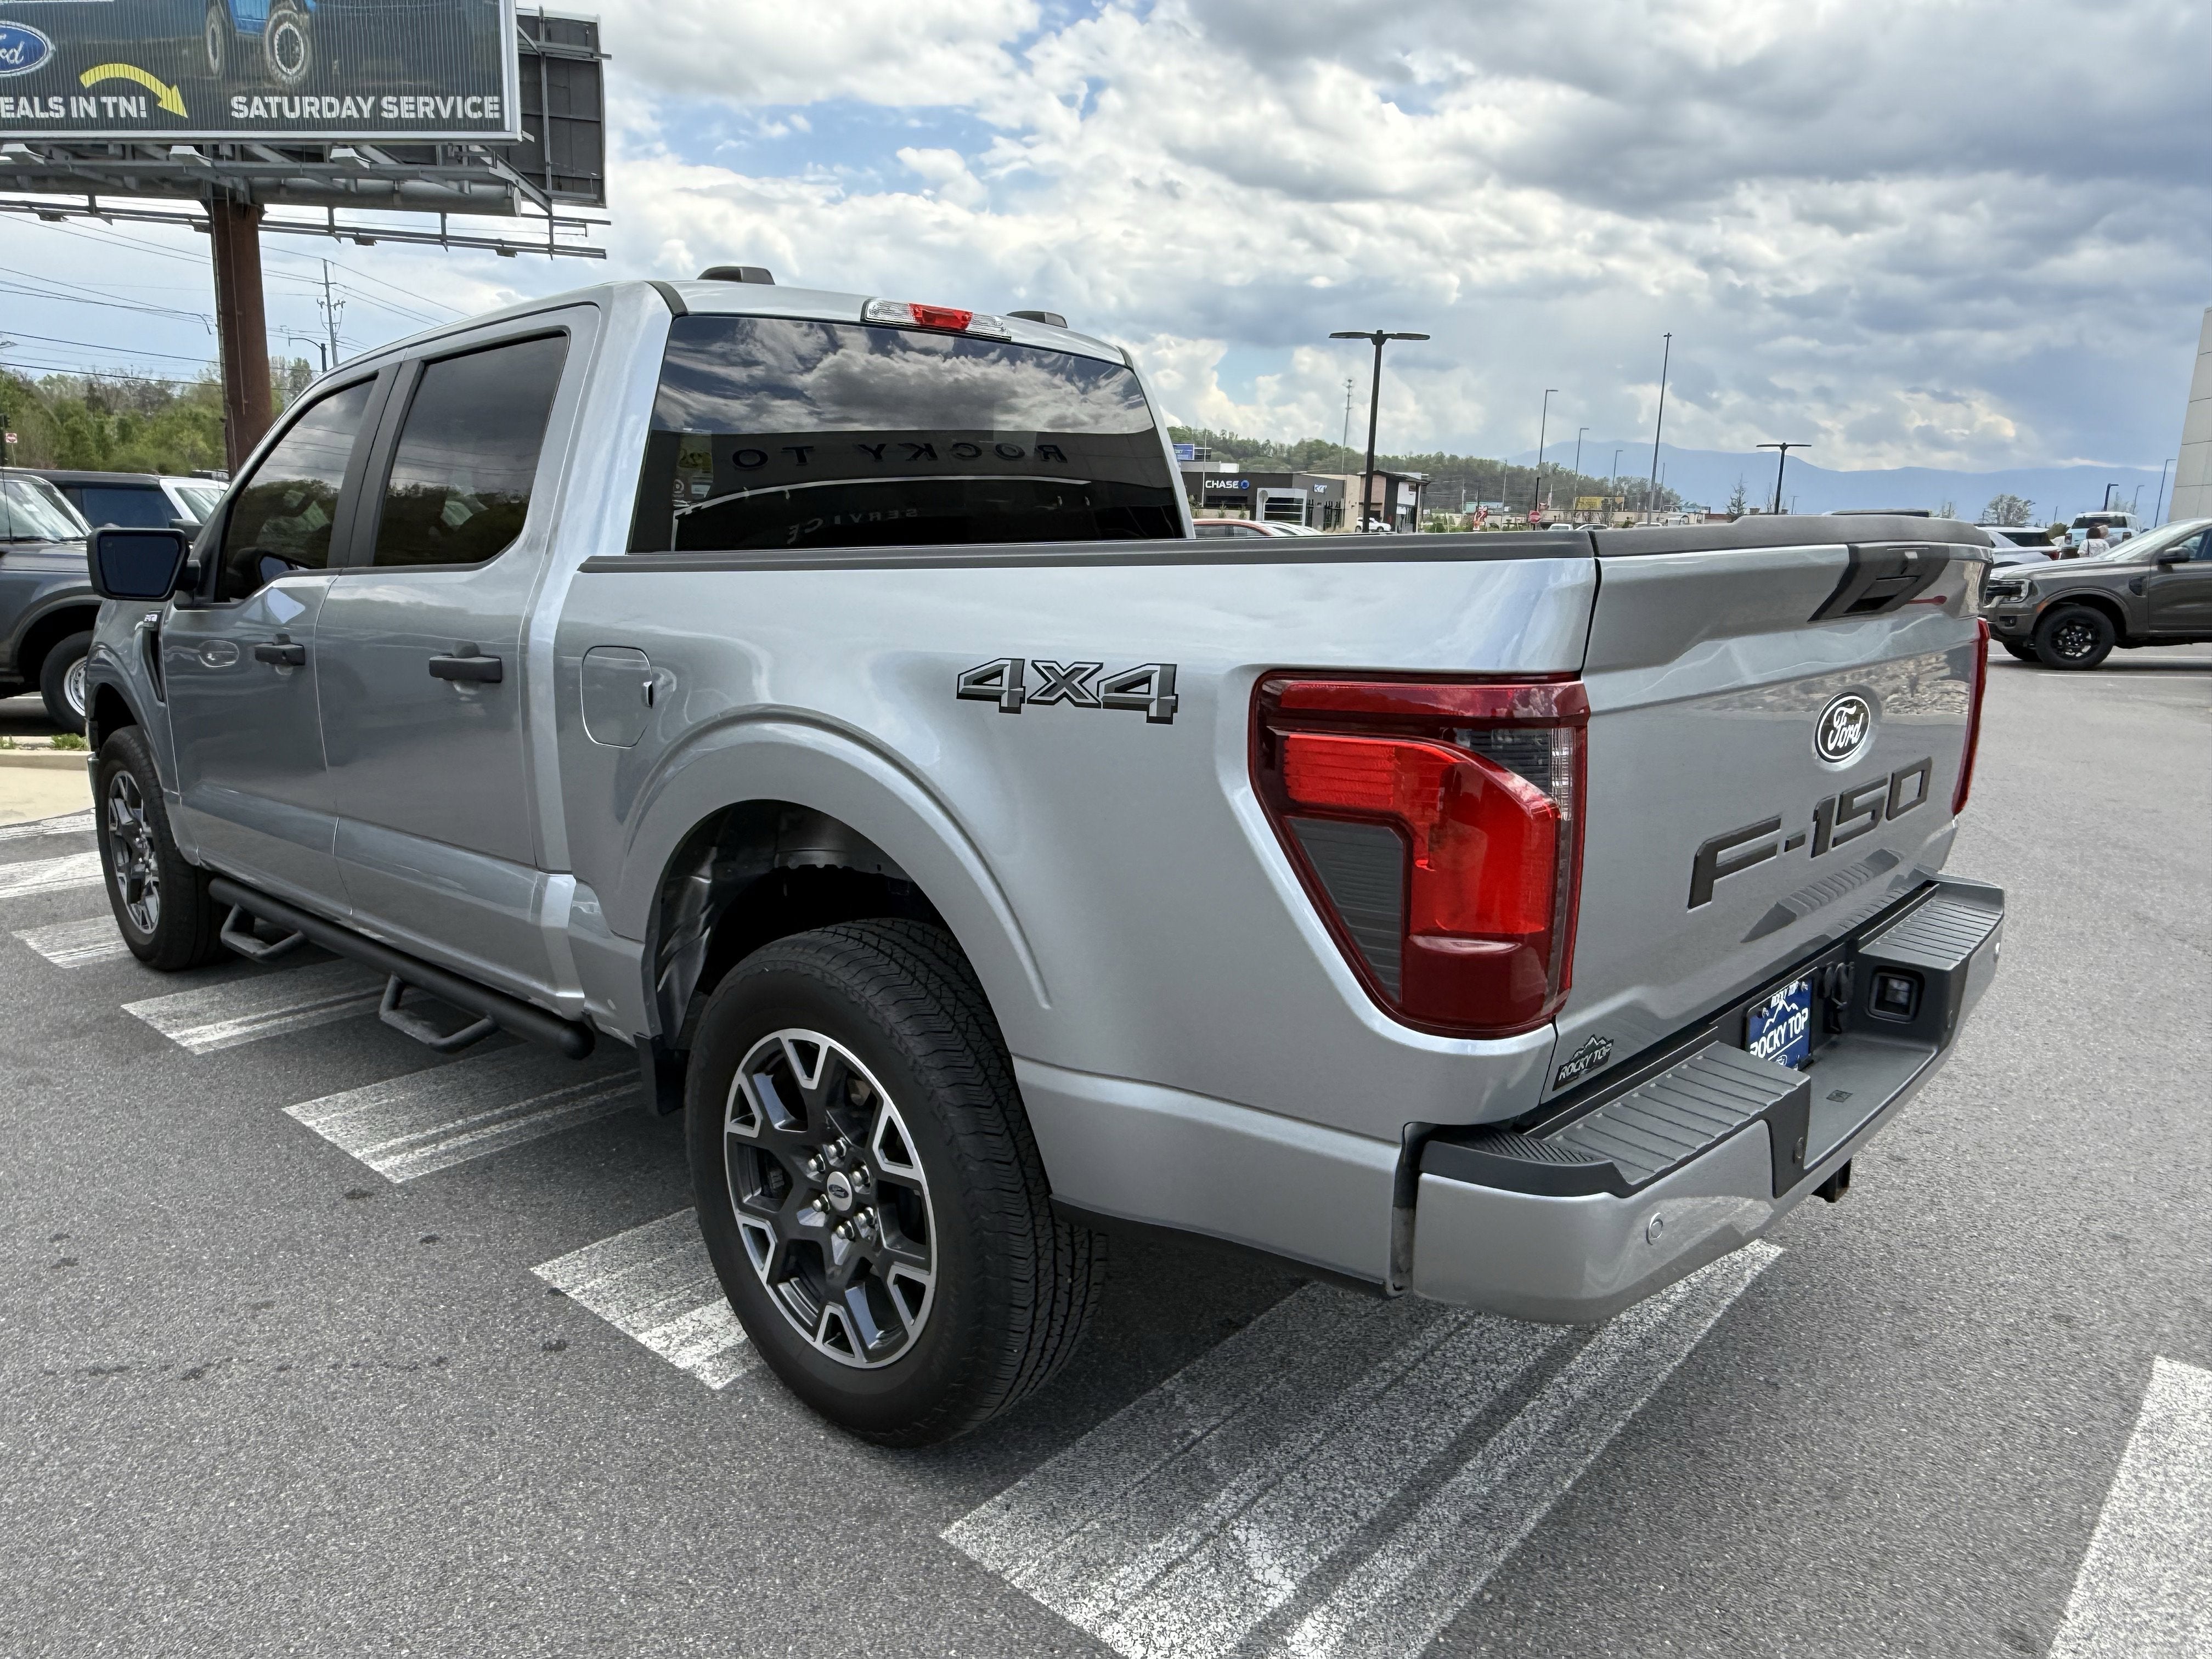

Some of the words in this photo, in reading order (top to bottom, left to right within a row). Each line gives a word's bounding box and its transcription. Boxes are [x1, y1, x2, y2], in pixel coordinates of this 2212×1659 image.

[0, 96, 65, 118] EALS
[70, 96, 97, 118] IN
[100, 96, 147, 118] TN!
[230, 95, 375, 119] SATURDAY
[380, 95, 501, 119] SERVICE
[1205, 480, 1239, 489] CHASE
[1827, 704, 1864, 751] Ford
[1688, 757, 1932, 911] F-150
[1750, 1021, 1787, 1058] ROCKY
[1788, 1007, 1809, 1039] TOP
[1558, 1052, 1593, 1081] ROCKY
